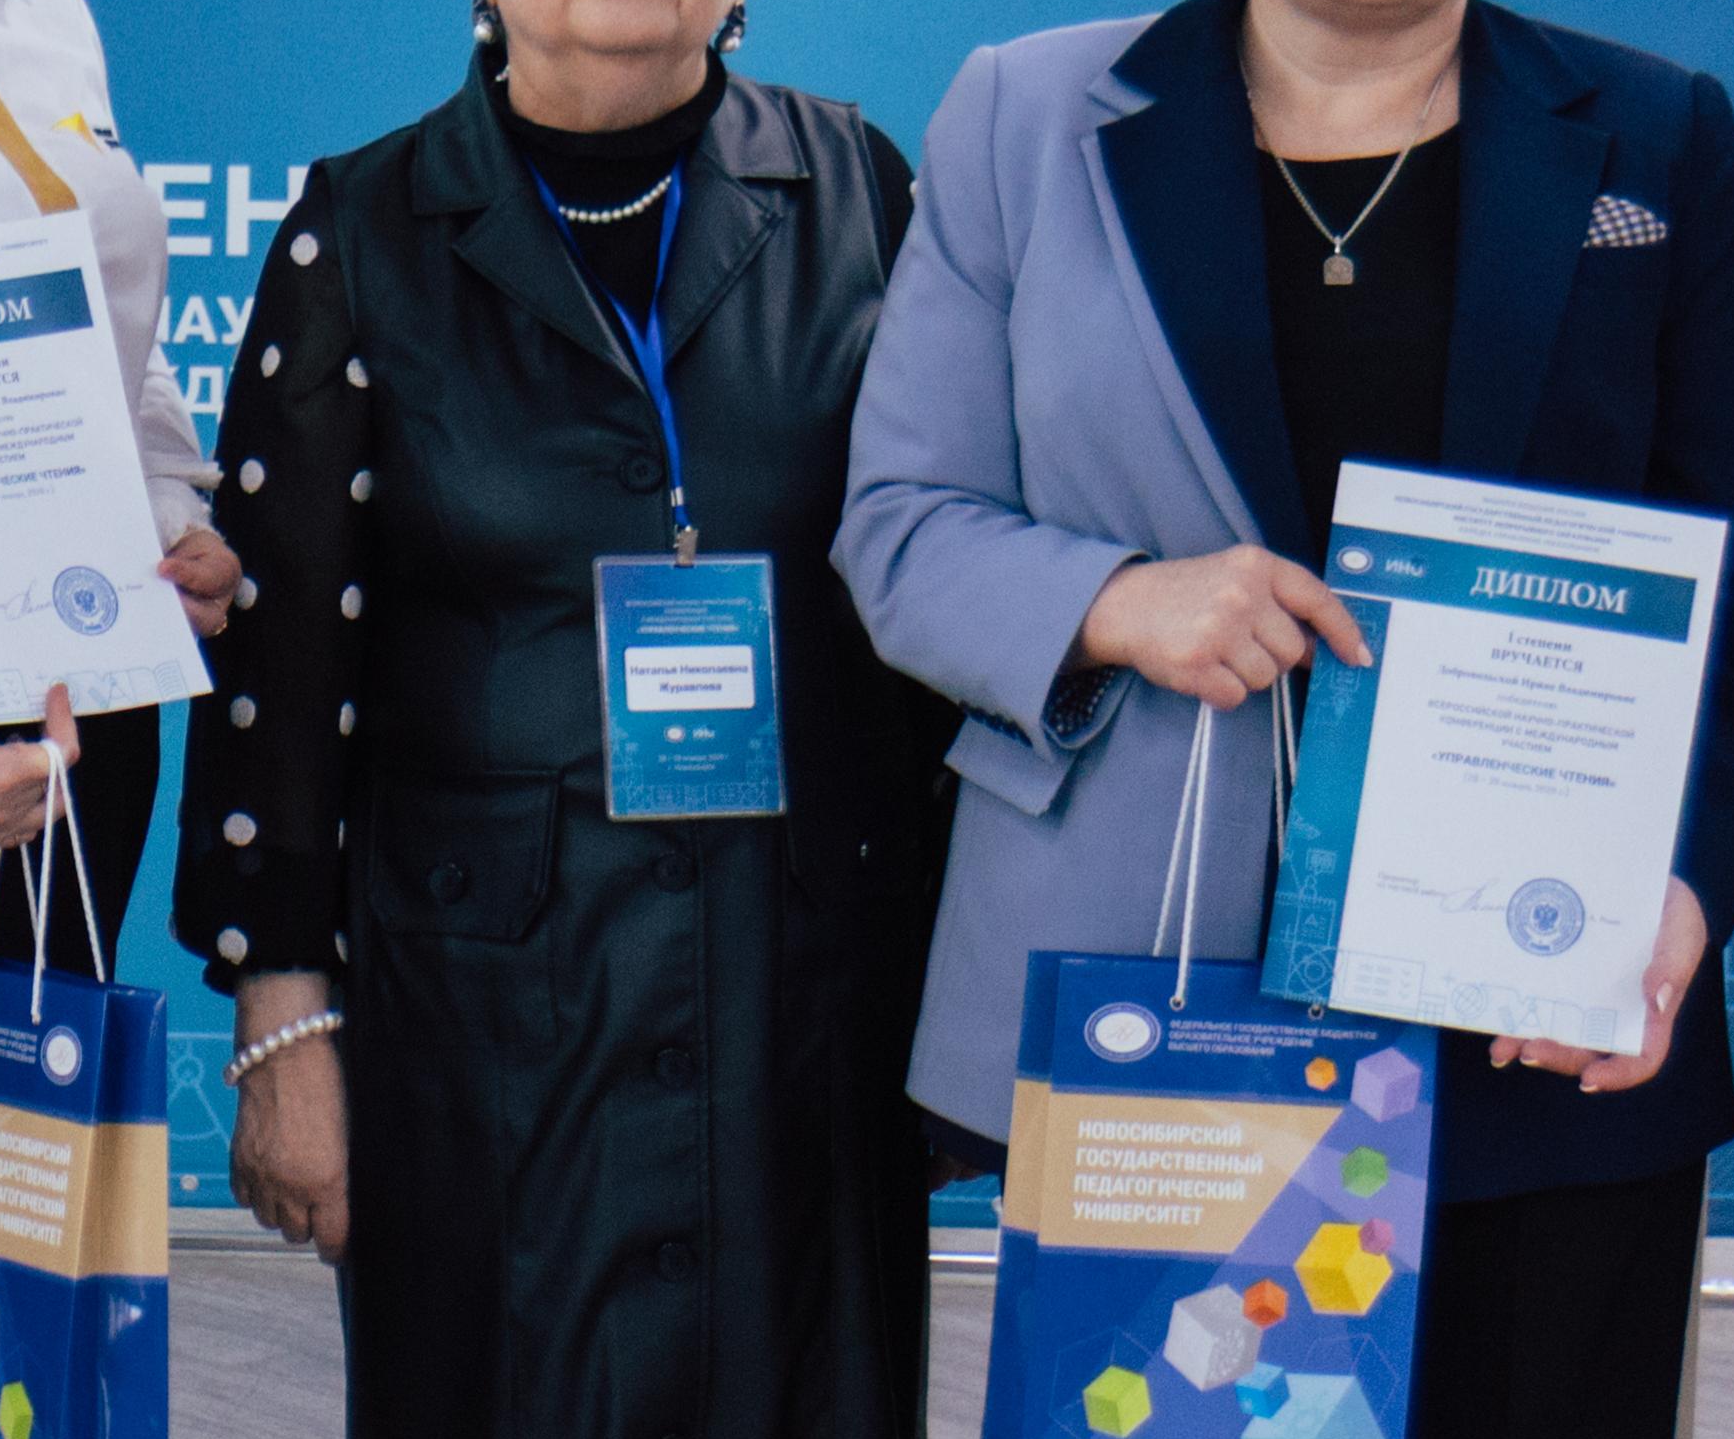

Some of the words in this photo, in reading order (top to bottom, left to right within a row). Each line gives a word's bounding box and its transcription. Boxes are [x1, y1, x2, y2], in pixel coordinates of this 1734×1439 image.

[1469, 566, 1629, 617] ДИПЛОМ
[1490, 647, 1583, 673] ВРУЧАЕТСЯ
[1077, 1120, 1242, 1148] НОВОСИБИРСКИЙ
[1075, 1146, 1264, 1176] ГОСУДАРСТВЕННЫЙ
[1073, 1174, 1247, 1202] ПЕДАГОГИЧЕСКИЙ
[1072, 1201, 1204, 1226] УНИВЕРСИТЕТ
